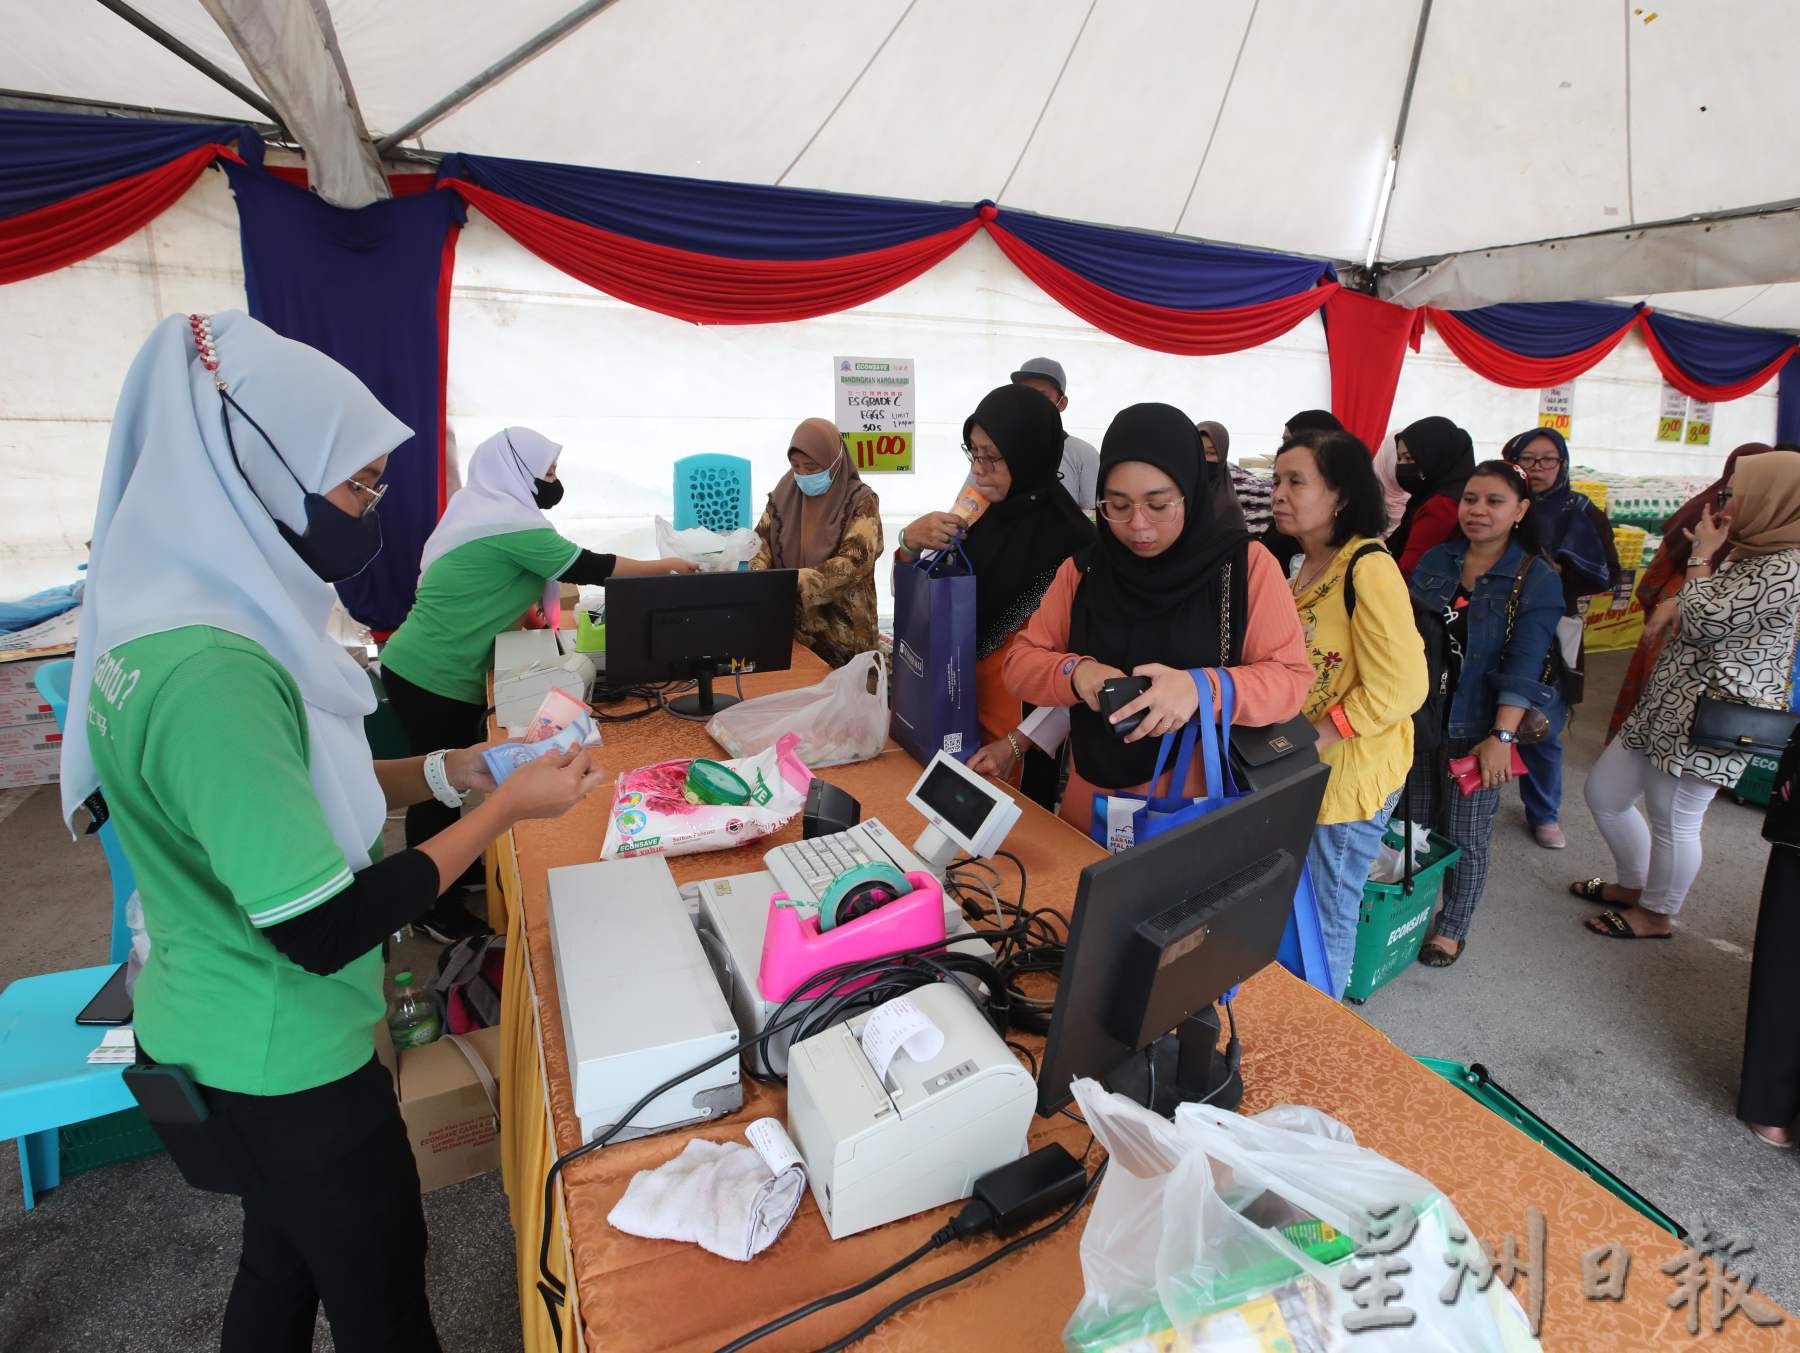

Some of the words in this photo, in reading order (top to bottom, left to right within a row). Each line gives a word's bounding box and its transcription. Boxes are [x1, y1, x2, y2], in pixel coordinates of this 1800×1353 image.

[841, 376, 876, 384] BANDINGKAN
[861, 396, 891, 408] GRADE
[860, 409, 885, 420] EGGS
[94, 652, 141, 711] antu?
[620, 838, 658, 853] ECONSAVE
[1387, 906, 1431, 946] ECONSAVE
[420, 1130, 458, 1146] ECONSAVE
[459, 1124, 478, 1134] CASH
